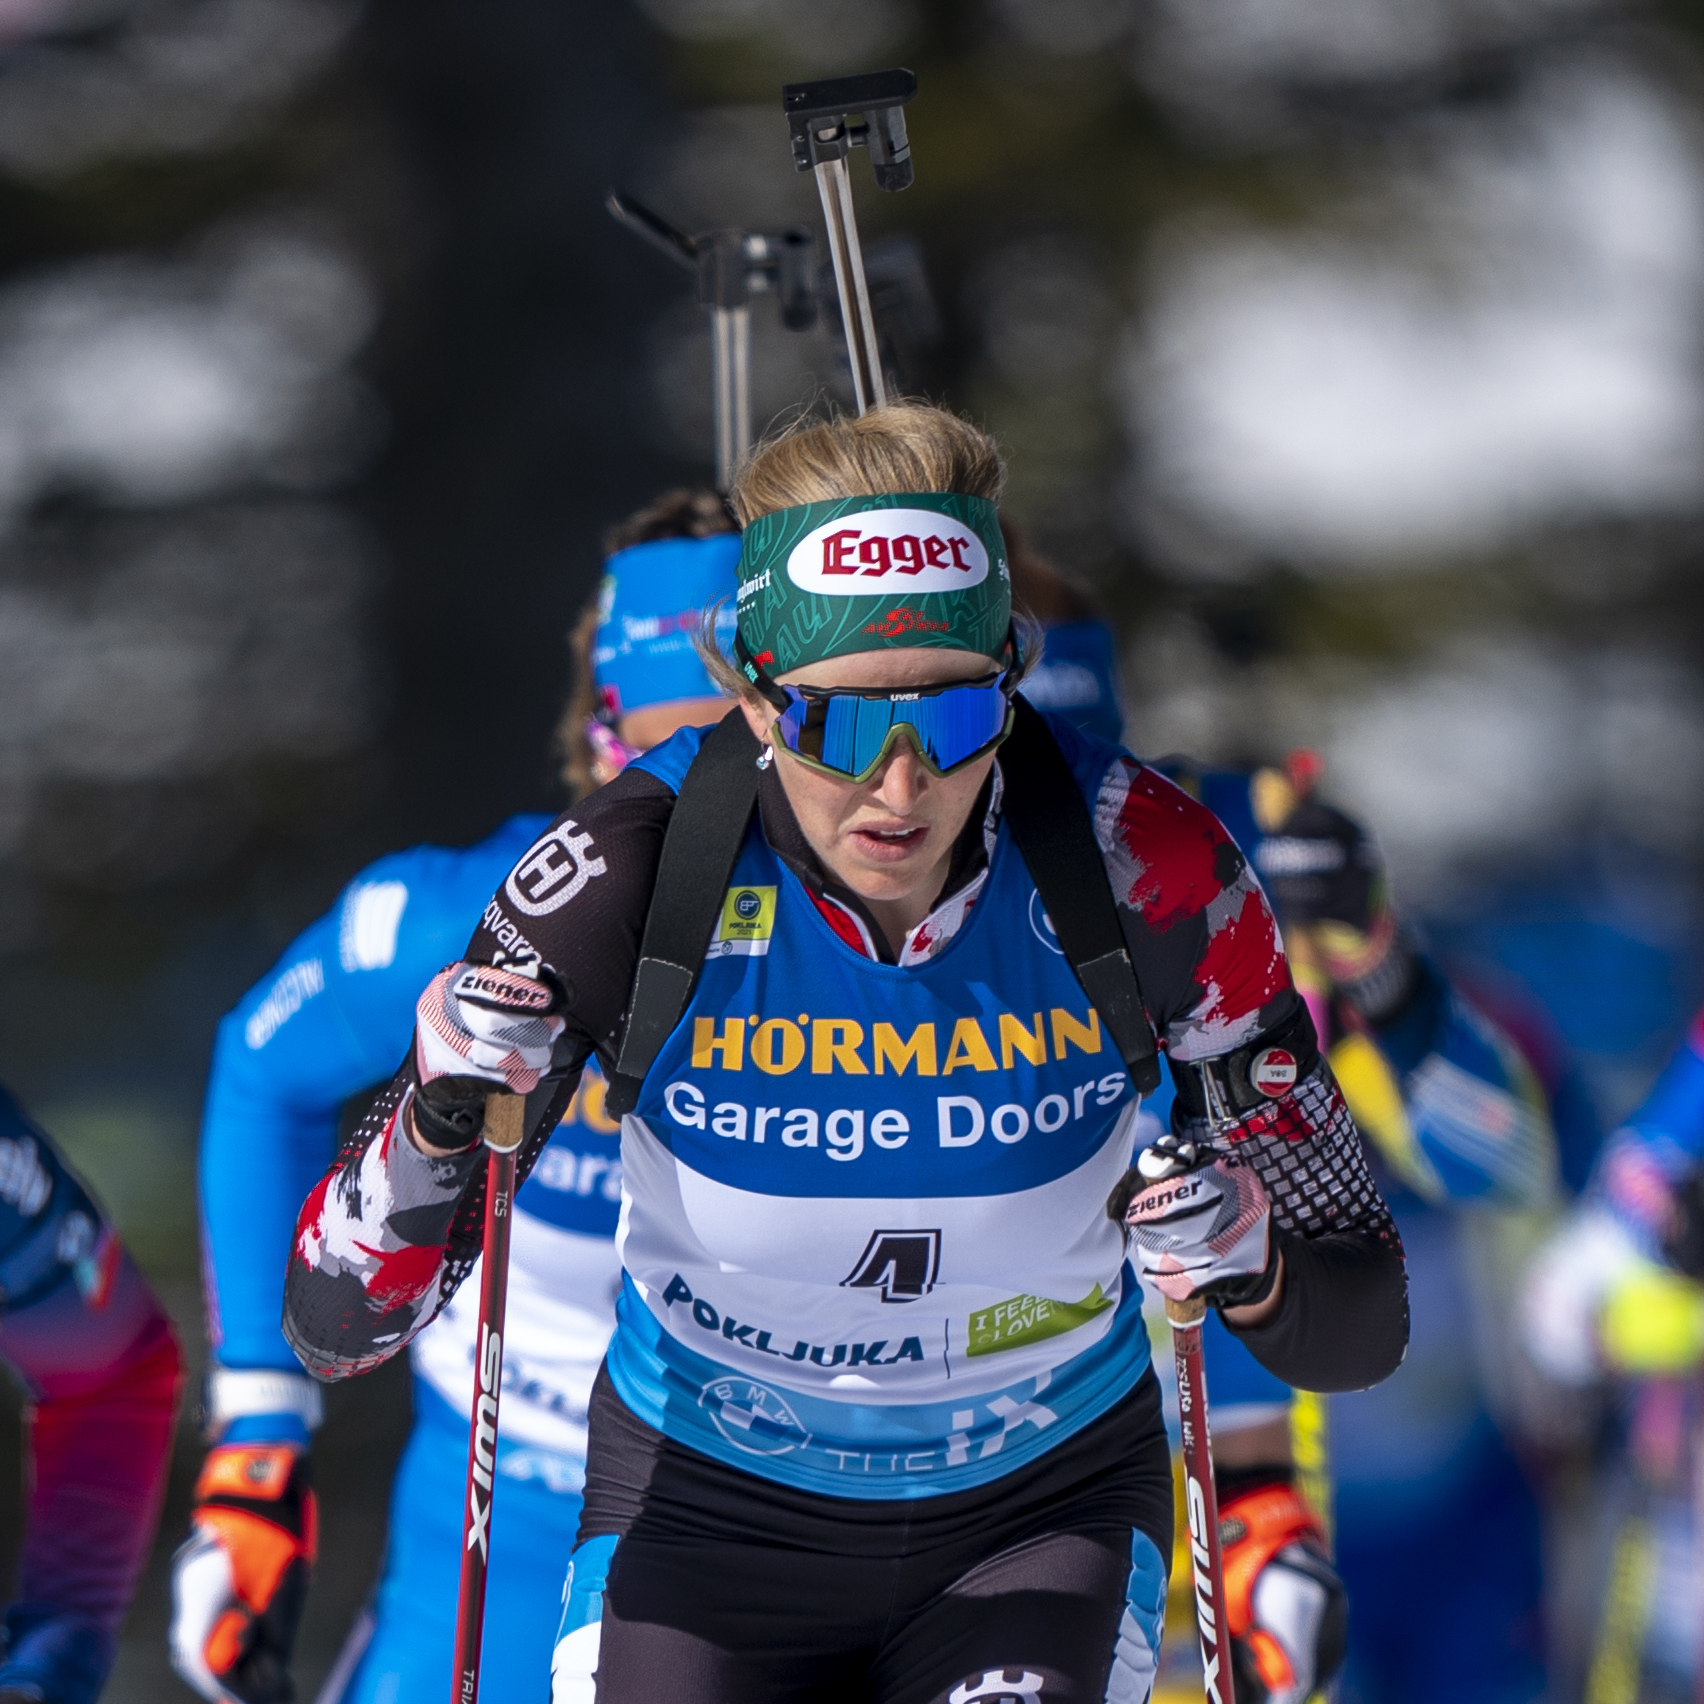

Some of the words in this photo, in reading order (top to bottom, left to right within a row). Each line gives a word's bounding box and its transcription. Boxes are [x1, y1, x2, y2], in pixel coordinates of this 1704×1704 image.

[821, 529, 971, 577] Egger
[890, 692, 920, 702] uvex
[461, 975, 547, 1004] ziener
[690, 1007, 1103, 1076] HÖRMANN
[663, 1081, 911, 1162] Garage
[936, 1072, 1128, 1149] Doors
[493, 1190, 508, 1218] TCS
[1128, 1179, 1203, 1219] ziener
[839, 1228, 943, 1304] 4
[661, 1272, 925, 1368] POKLJUKA
[467, 1321, 501, 1566] SWIX
